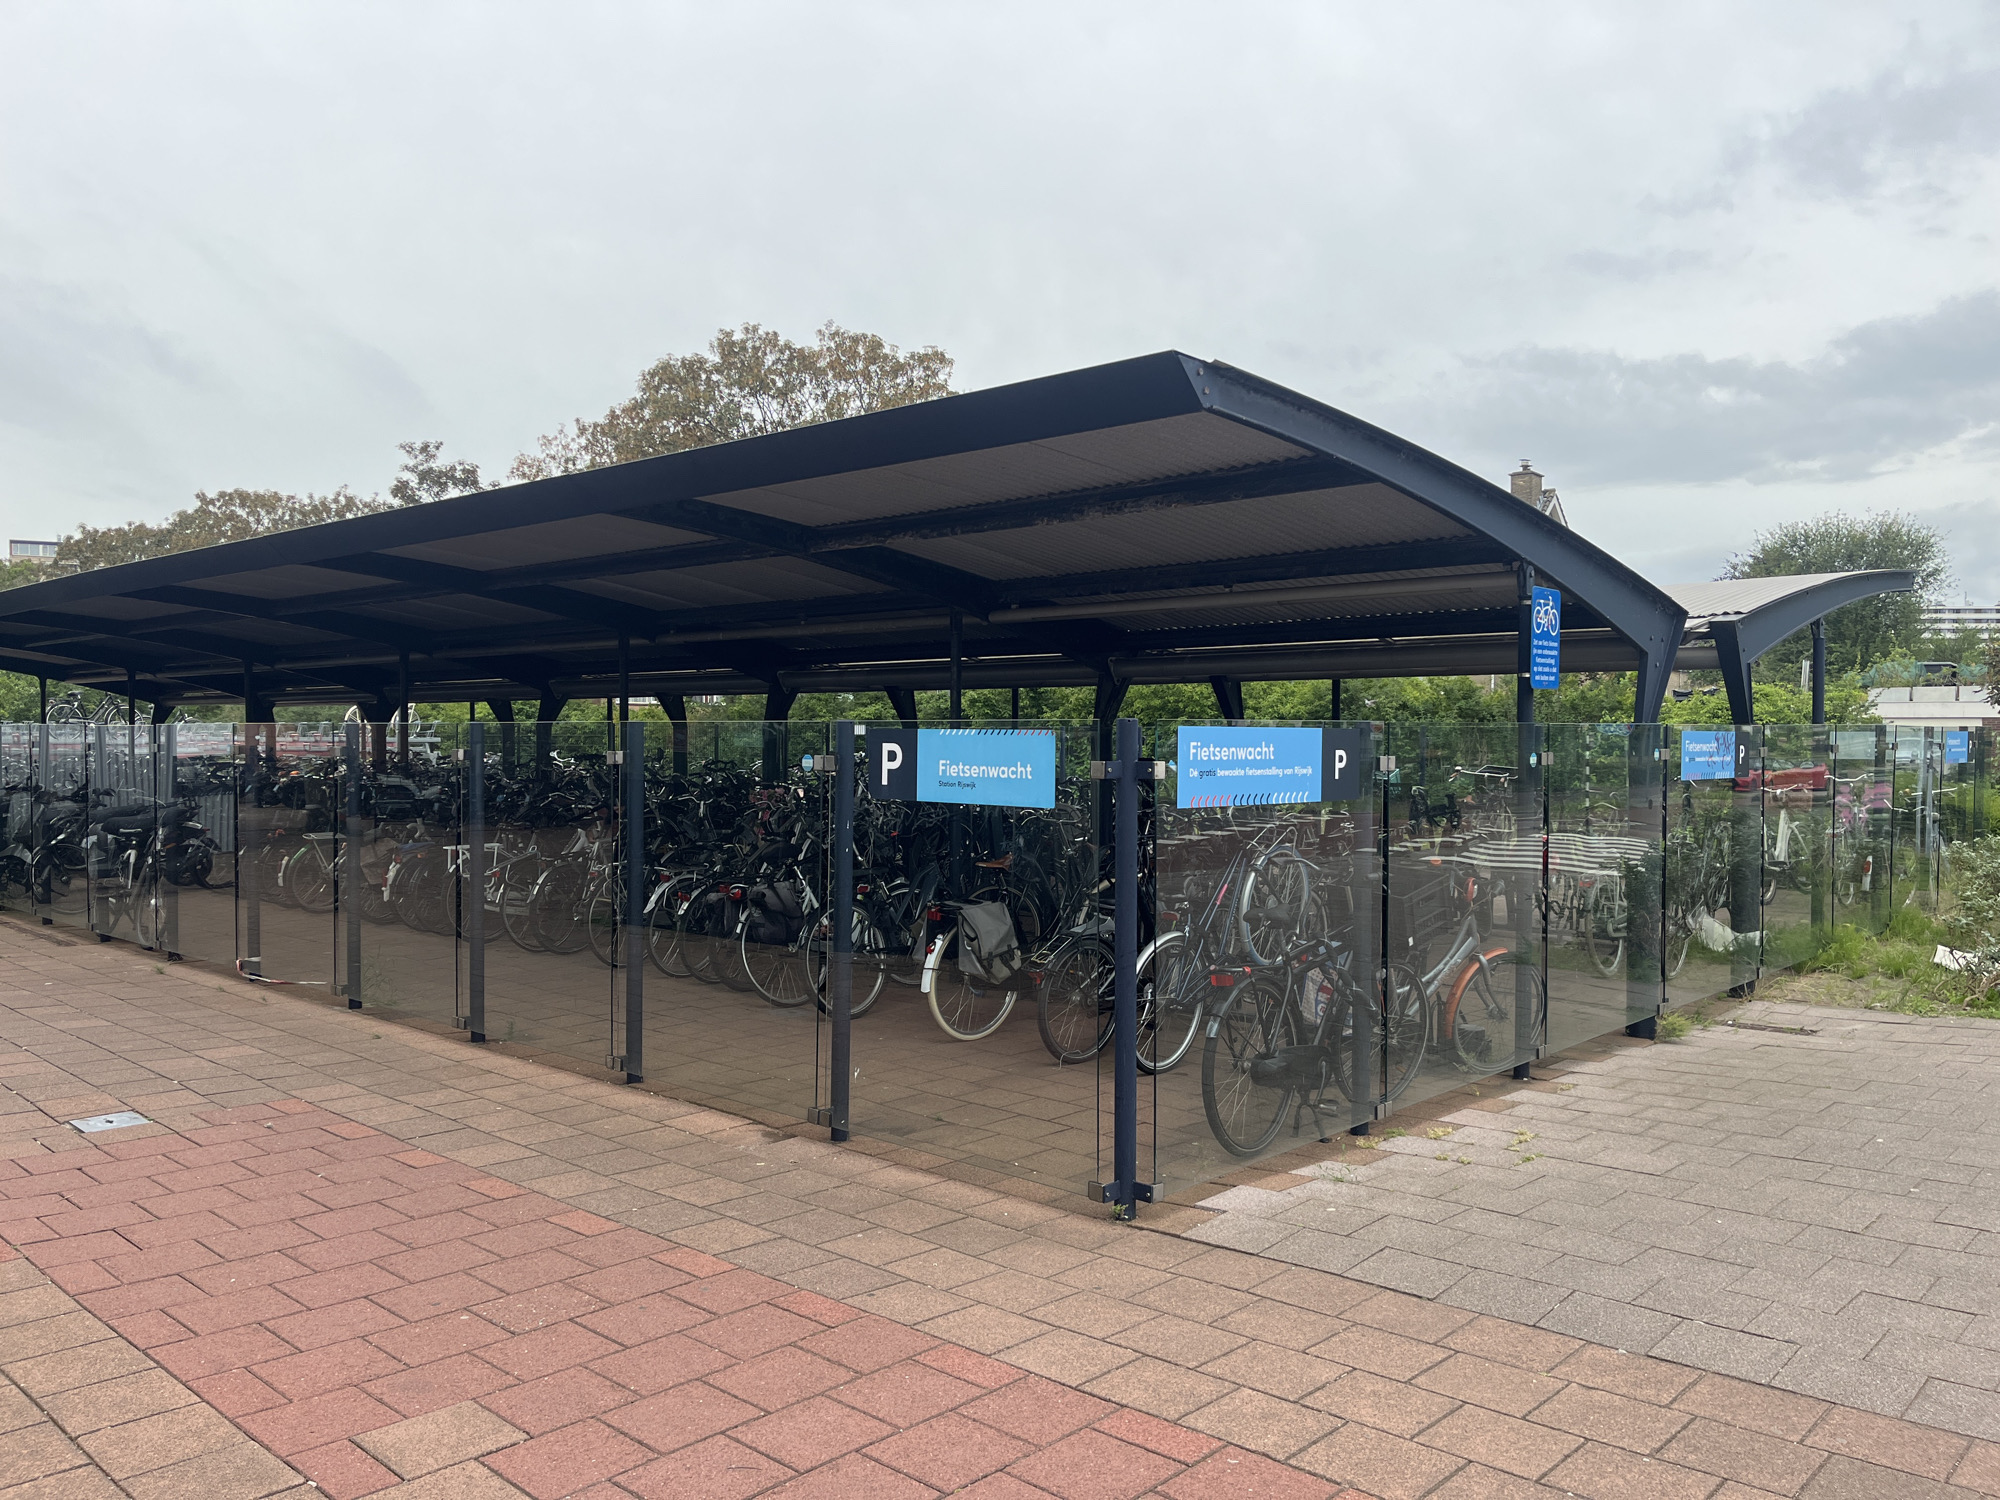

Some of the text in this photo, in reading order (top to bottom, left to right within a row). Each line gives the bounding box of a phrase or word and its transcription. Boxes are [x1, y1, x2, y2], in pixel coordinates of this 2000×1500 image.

[1189, 741, 1275, 761] Fietsenwacht
[1739, 745, 1745, 765] P
[881, 742, 903, 786] P
[938, 759, 1033, 780] Fietsenwacht
[1198, 767, 1216, 780] gratis
[1216, 766, 1245, 777] bewaakte
[1245, 765, 1283, 778] fietsenstalling
[1283, 767, 1293, 776] van
[1294, 765, 1313, 777] Rijswijk
[1334, 749, 1348, 780] P
[938, 780, 977, 790] Station Rijswijk
